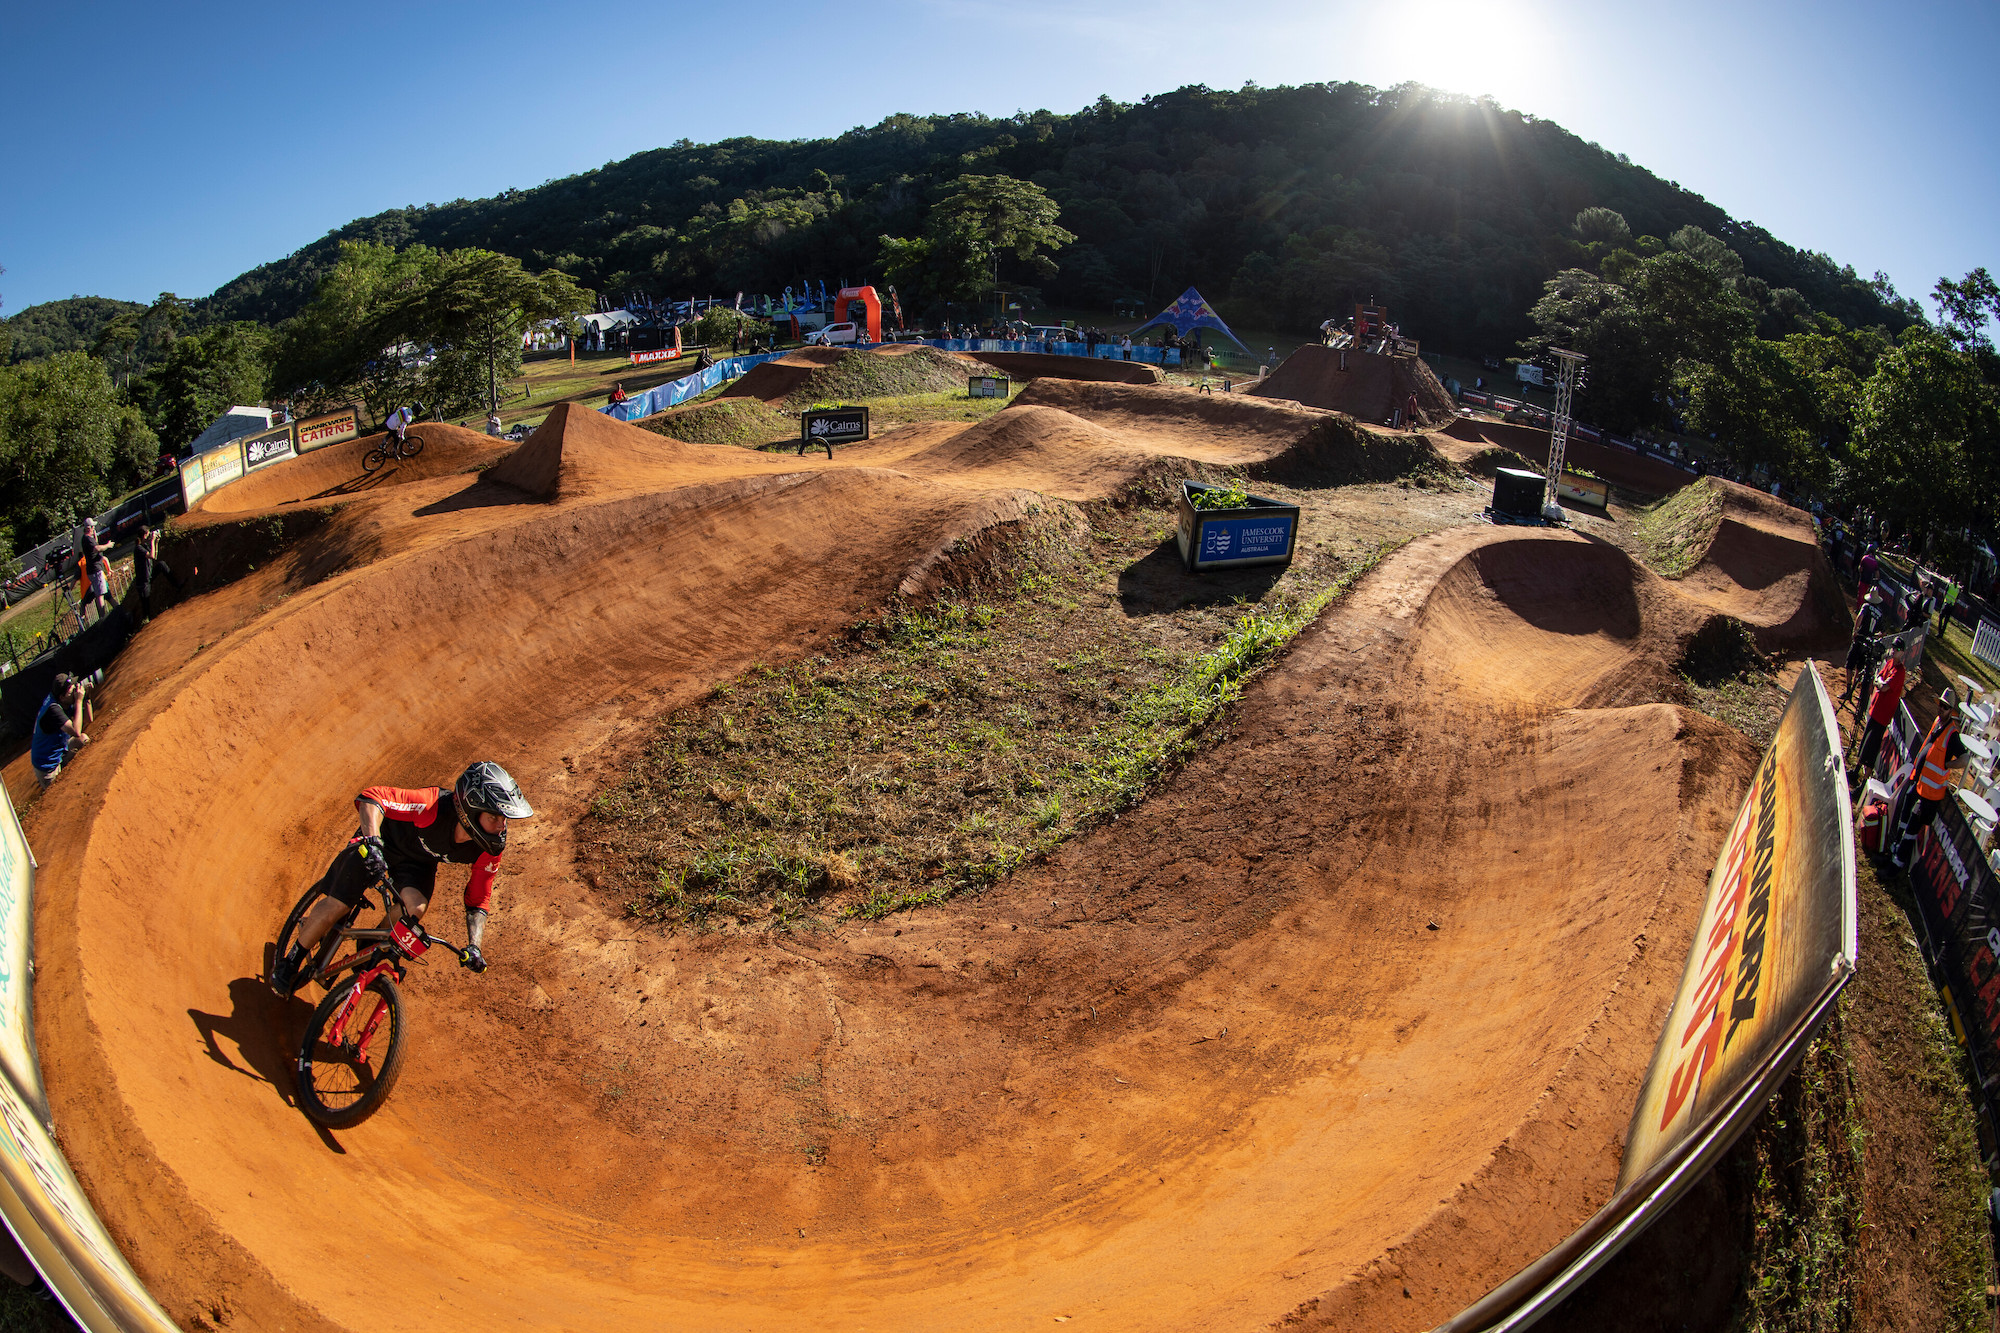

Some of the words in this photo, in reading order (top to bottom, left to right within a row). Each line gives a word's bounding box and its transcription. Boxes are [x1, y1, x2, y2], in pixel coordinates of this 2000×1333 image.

[638, 350, 677, 362] MAXXIS
[300, 415, 353, 433] CRANKWORX
[301, 421, 354, 443] CAIRNS
[830, 420, 861, 431] Cairns
[264, 438, 289, 453] Cairns
[205, 470, 217, 481] GREAT
[217, 463, 233, 476] BARRIER
[1241, 534, 1285, 545] UNIVERSITY
[1242, 527, 1264, 537] JAMES
[1264, 526, 1285, 535] COOK
[1206, 530, 1217, 555] JCU
[1240, 545, 1269, 553] AUSTRALIA
[1723, 742, 1777, 1055] CRANKWORX
[402, 932, 417, 948] 31
[1660, 780, 1760, 1132] CAIRNS
